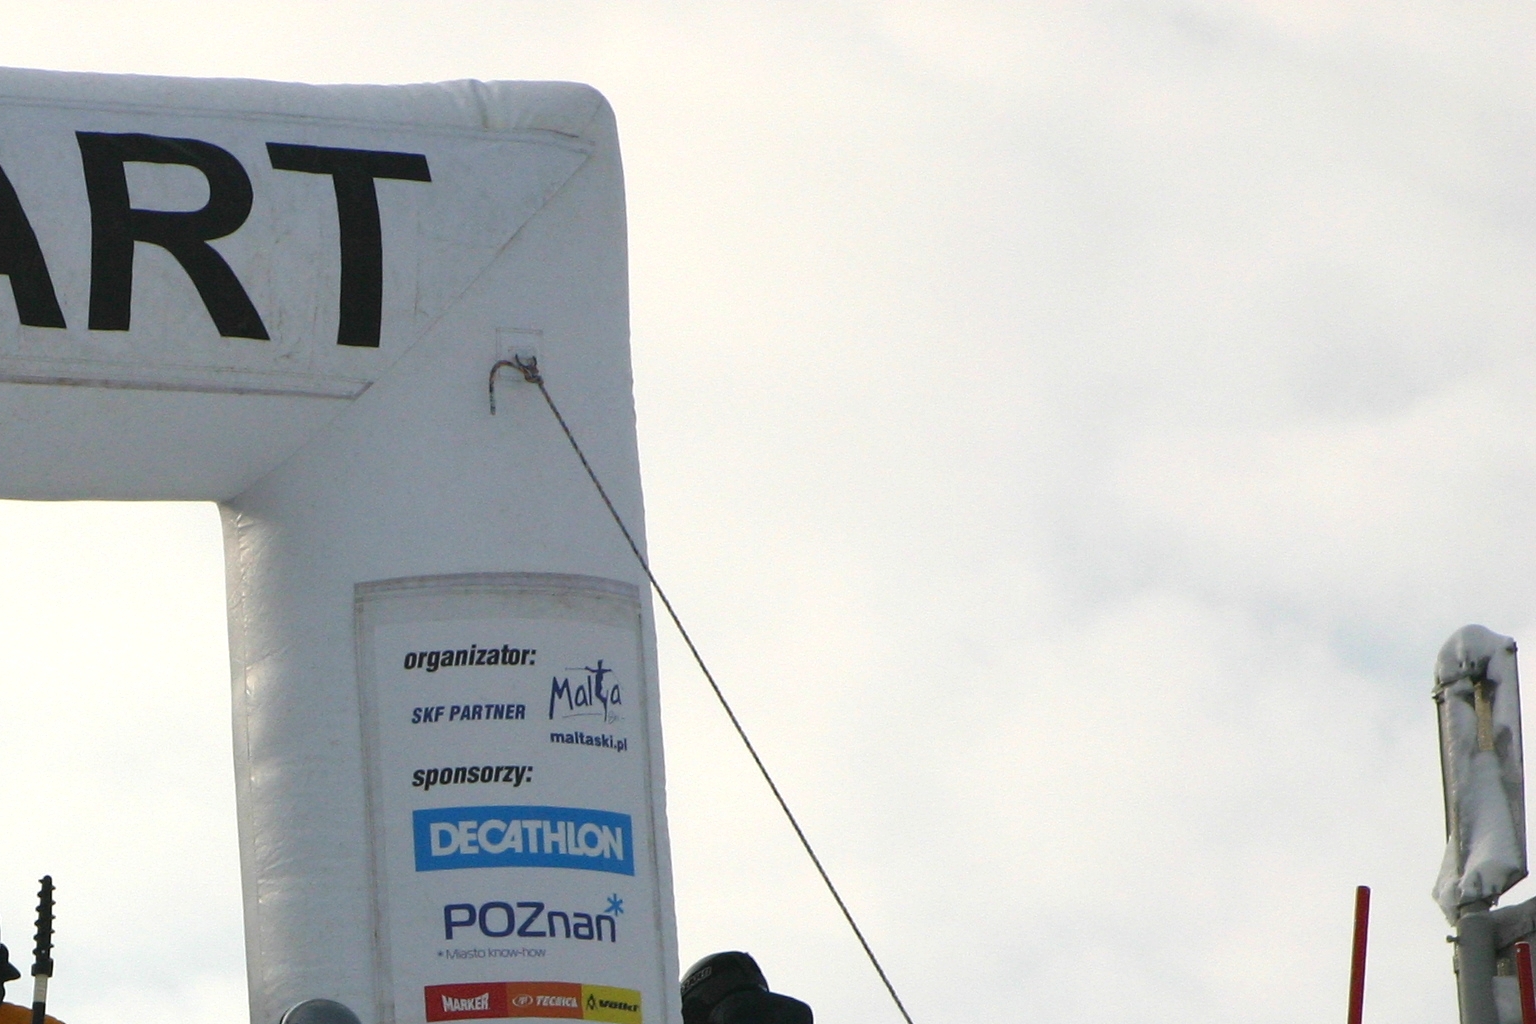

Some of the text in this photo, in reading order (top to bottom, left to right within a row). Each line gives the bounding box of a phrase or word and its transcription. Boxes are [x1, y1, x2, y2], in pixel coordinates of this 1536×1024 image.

[403, 644, 537, 672] organizator:
[411, 704, 526, 724] SKF PARTNER
[549, 730, 628, 752] maltaski.pl
[412, 764, 533, 791] sponsorzy:
[428, 819, 624, 862] DECATHLON
[441, 992, 491, 1012] MARKER
[535, 994, 579, 1008] TECNICA
